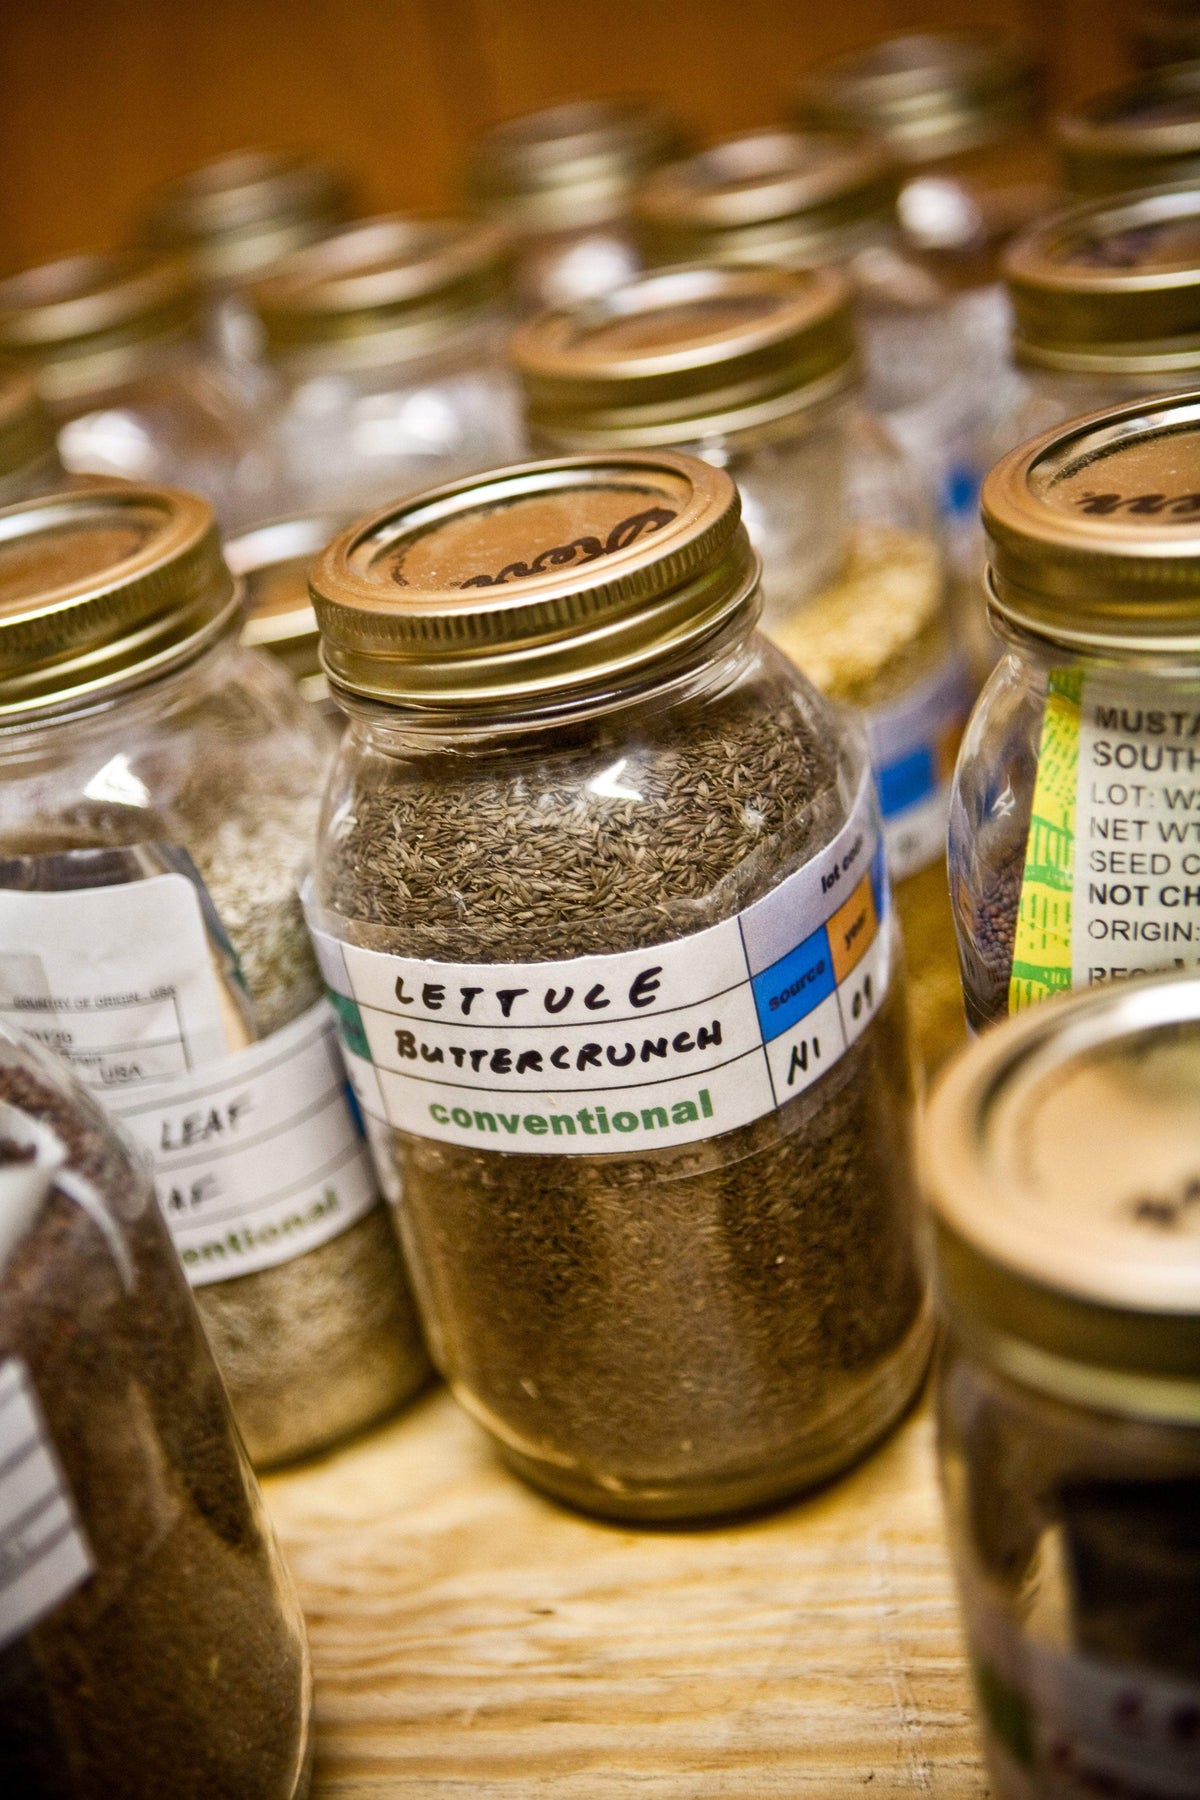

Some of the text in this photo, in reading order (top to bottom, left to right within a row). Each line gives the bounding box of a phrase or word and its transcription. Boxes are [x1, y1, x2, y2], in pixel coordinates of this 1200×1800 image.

[1091, 782, 1200, 811] LOT: W
[1090, 817, 1149, 841] NET
[1090, 850, 1171, 875] SEED
[1089, 883, 1150, 906] NOT
[1088, 918, 1200, 942] ORIGIN:
[395, 966, 663, 1018] LETTUCE
[769, 961, 825, 1012] source
[428, 1088, 714, 1136] conventional
